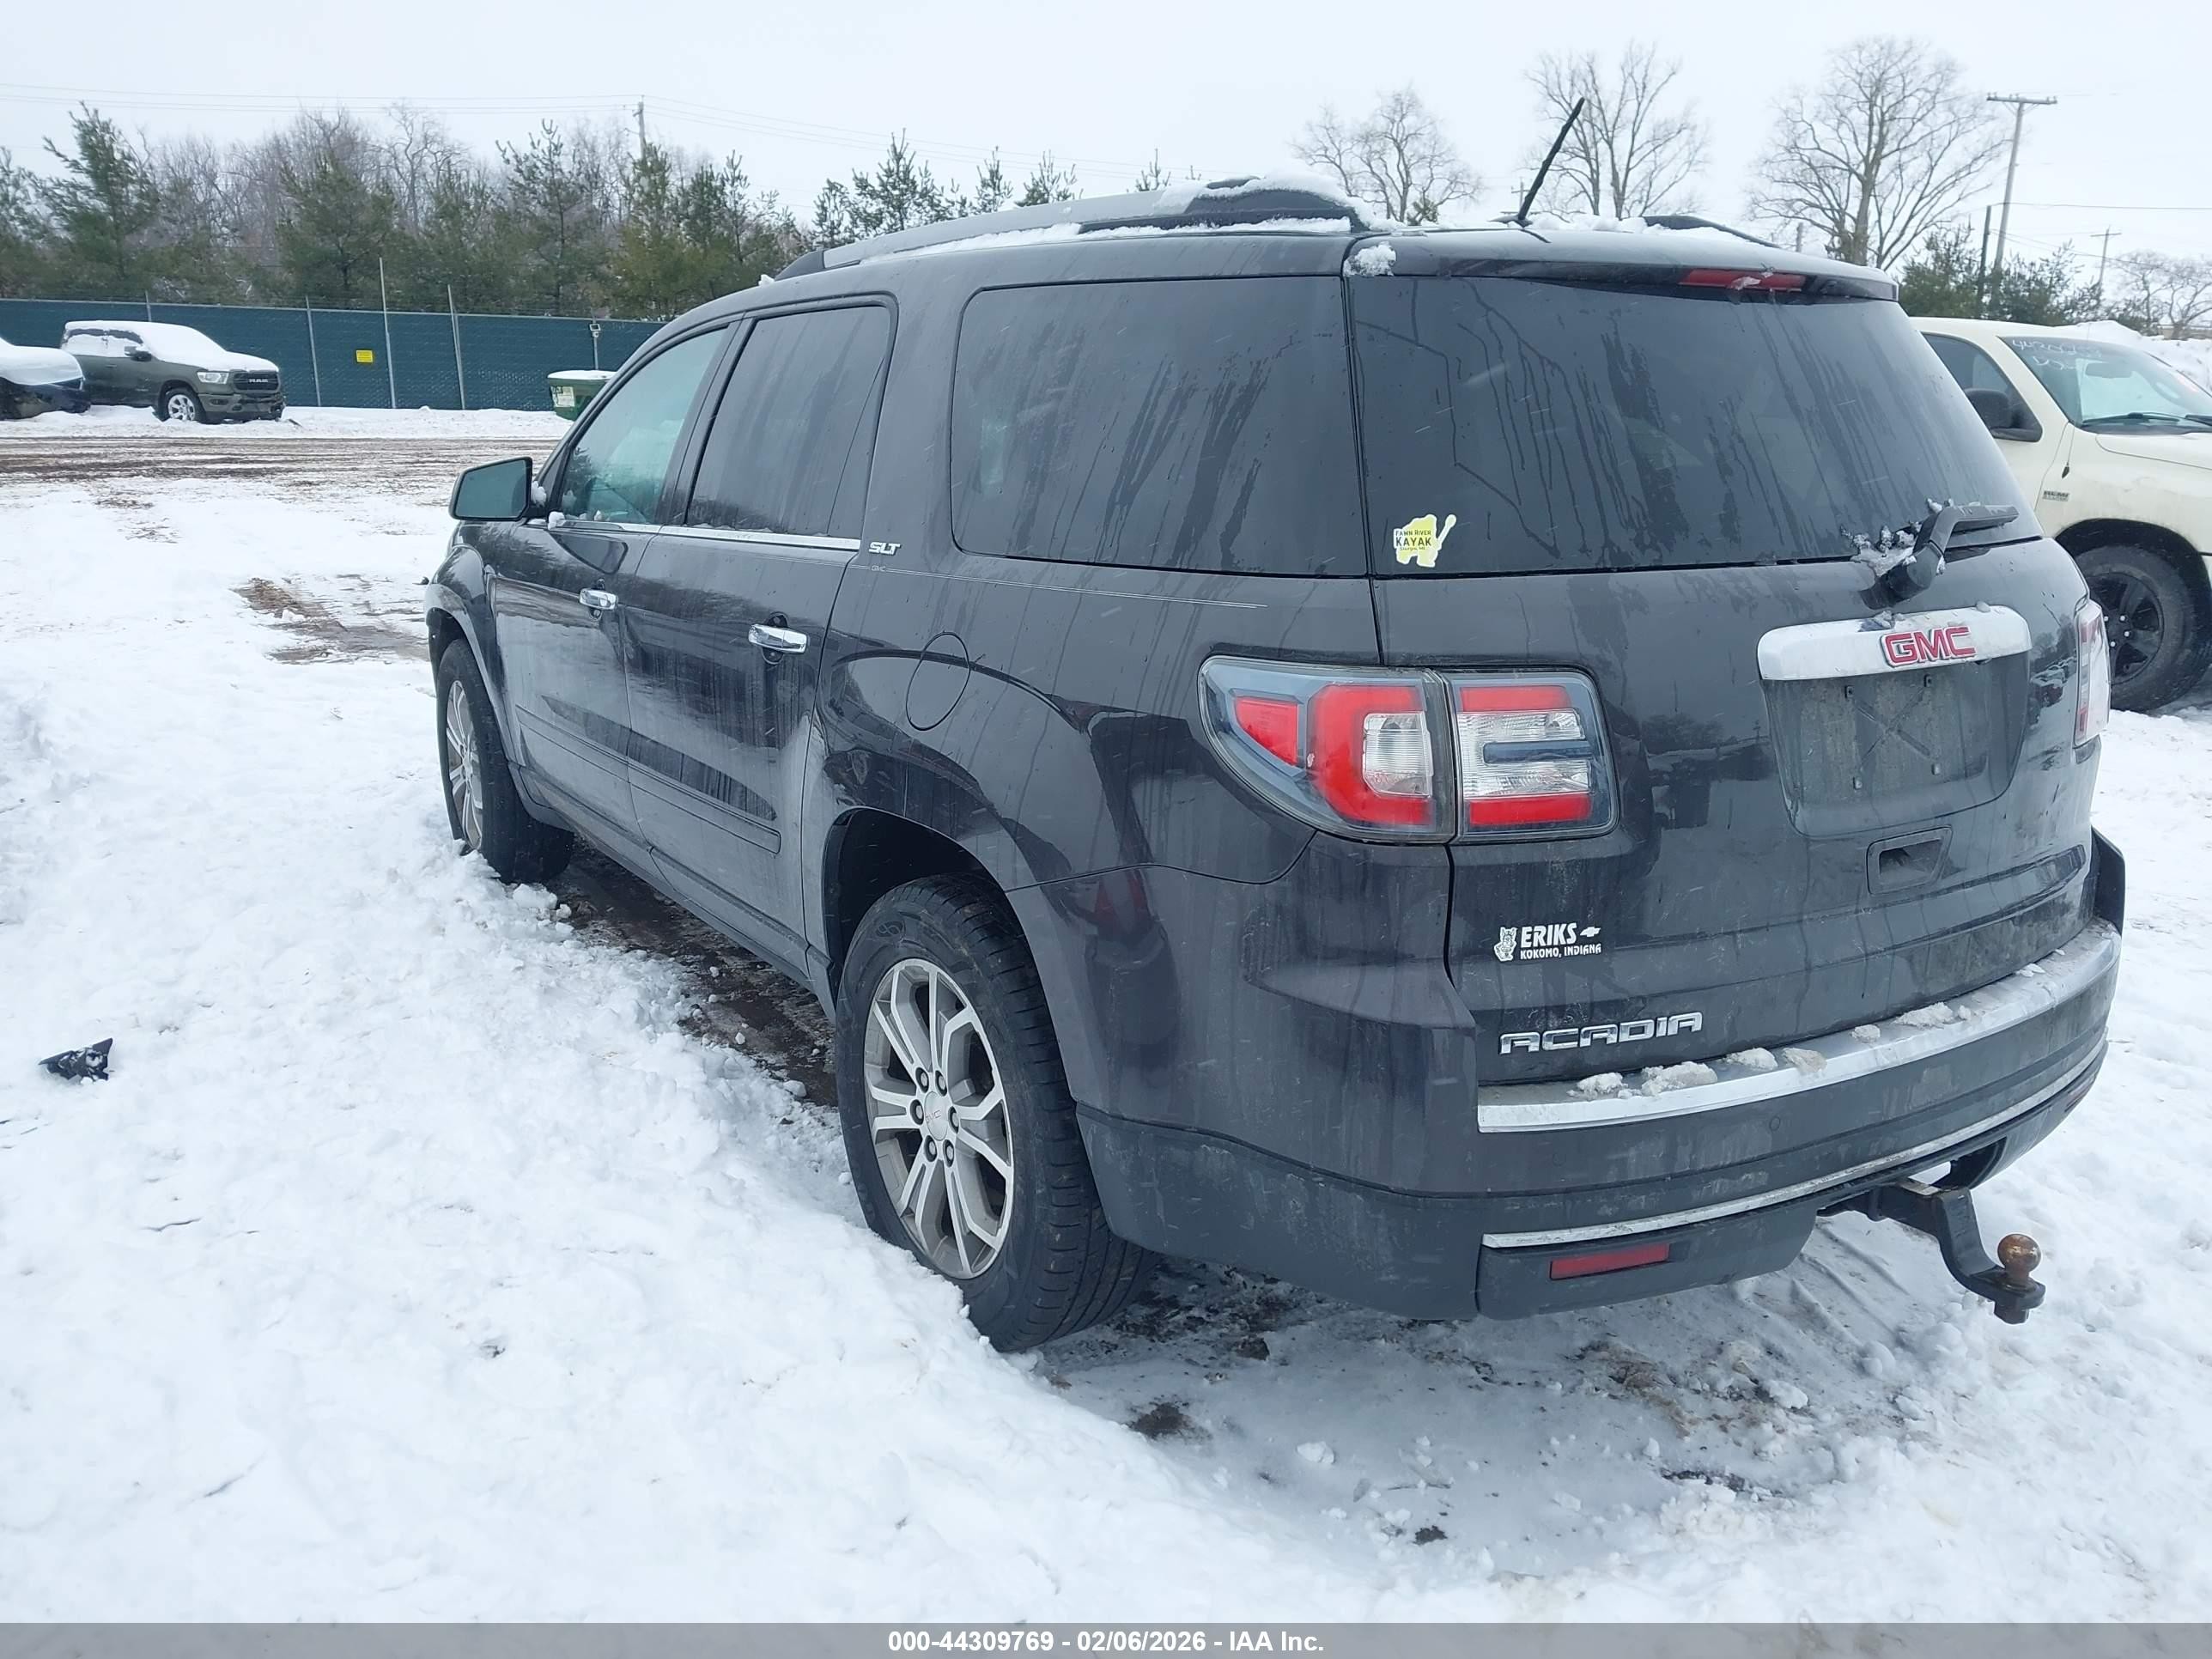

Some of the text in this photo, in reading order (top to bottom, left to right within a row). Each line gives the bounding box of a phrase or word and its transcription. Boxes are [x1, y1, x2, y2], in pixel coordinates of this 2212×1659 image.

[868, 542, 901, 556] SLT
[1395, 537, 1431, 546] KAYAK
[1881, 626, 1977, 667] GMC
[1521, 922, 1577, 948] ERIKS
[1520, 943, 1601, 960] KOKOMO, INDIANA
[1499, 1012, 1703, 1054] ACADIA
